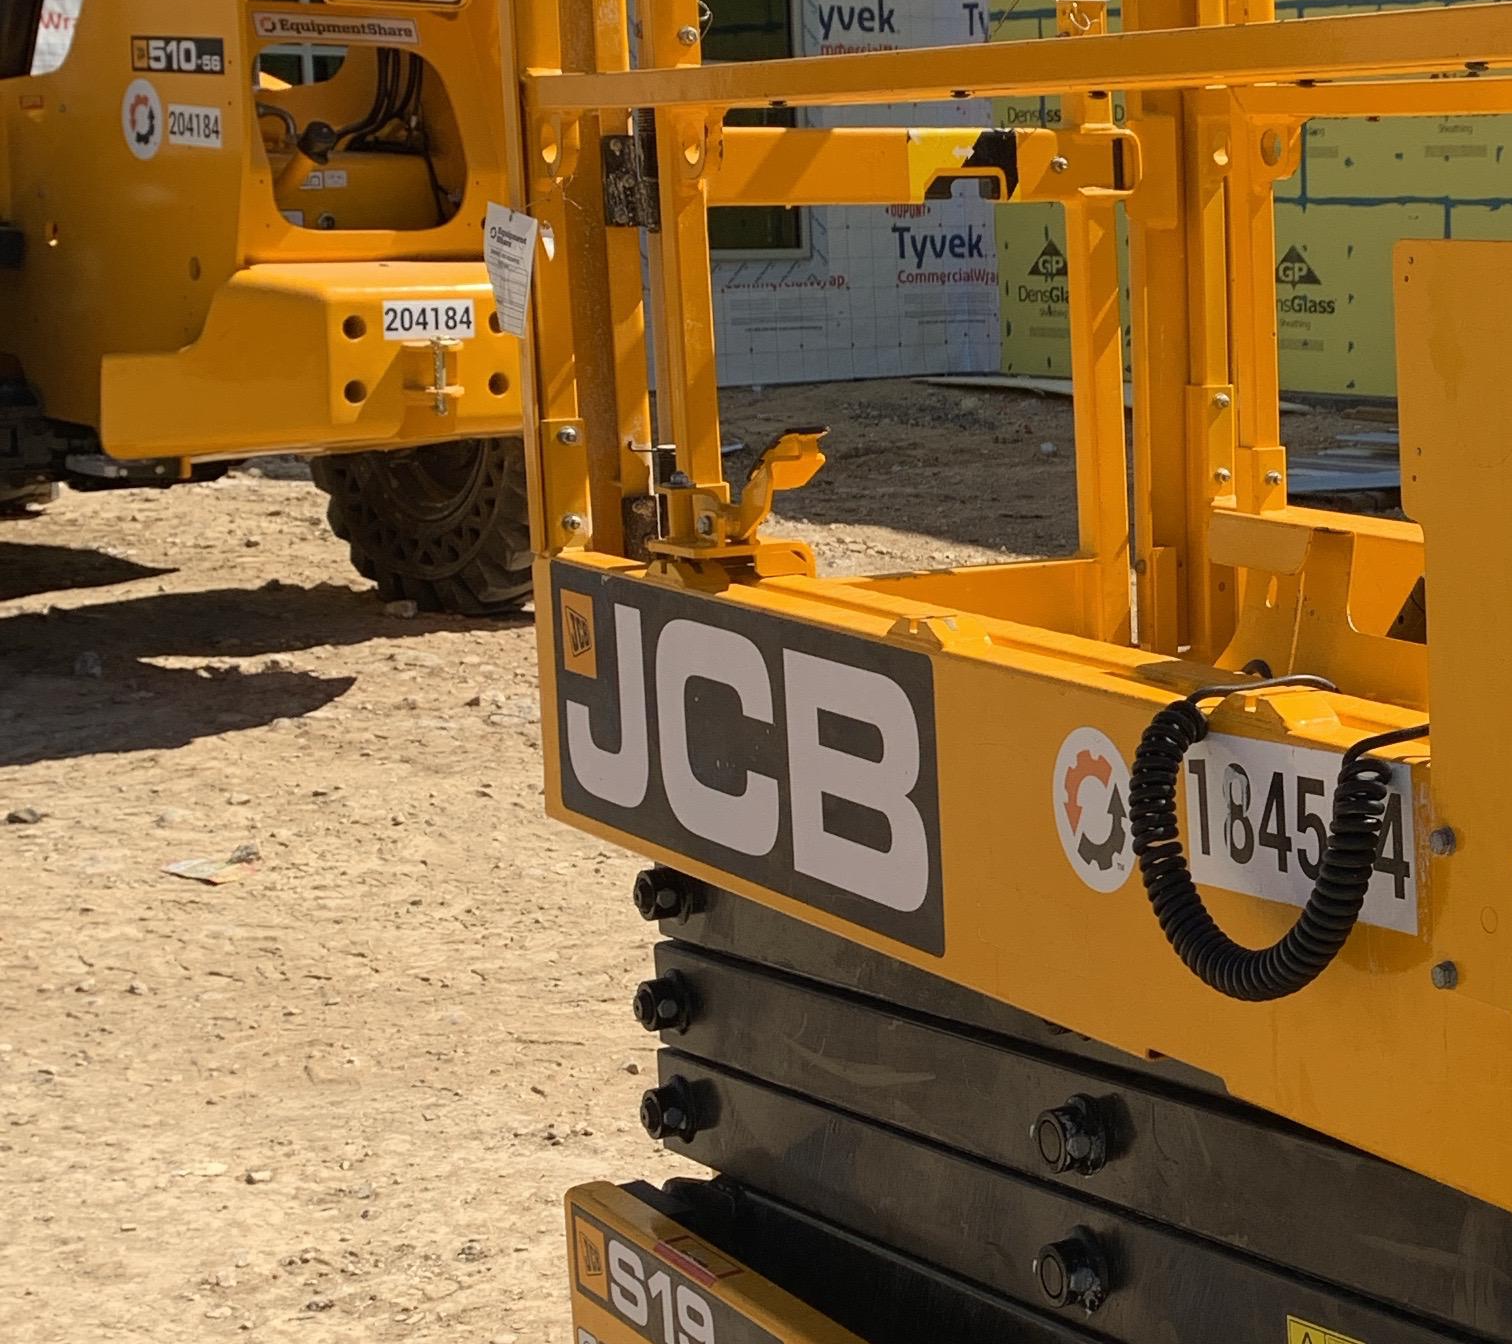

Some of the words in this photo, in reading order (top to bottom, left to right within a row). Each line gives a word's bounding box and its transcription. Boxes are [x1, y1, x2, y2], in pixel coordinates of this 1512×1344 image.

[279, 17, 414, 40] EquipmentShare
[168, 111, 220, 140] 204184
[892, 223, 983, 268] Tyvek
[1278, 261, 1309, 281] GP
[384, 306, 473, 332] 204184
[566, 602, 930, 913] JCB
[1187, 758, 1412, 901] 18454
